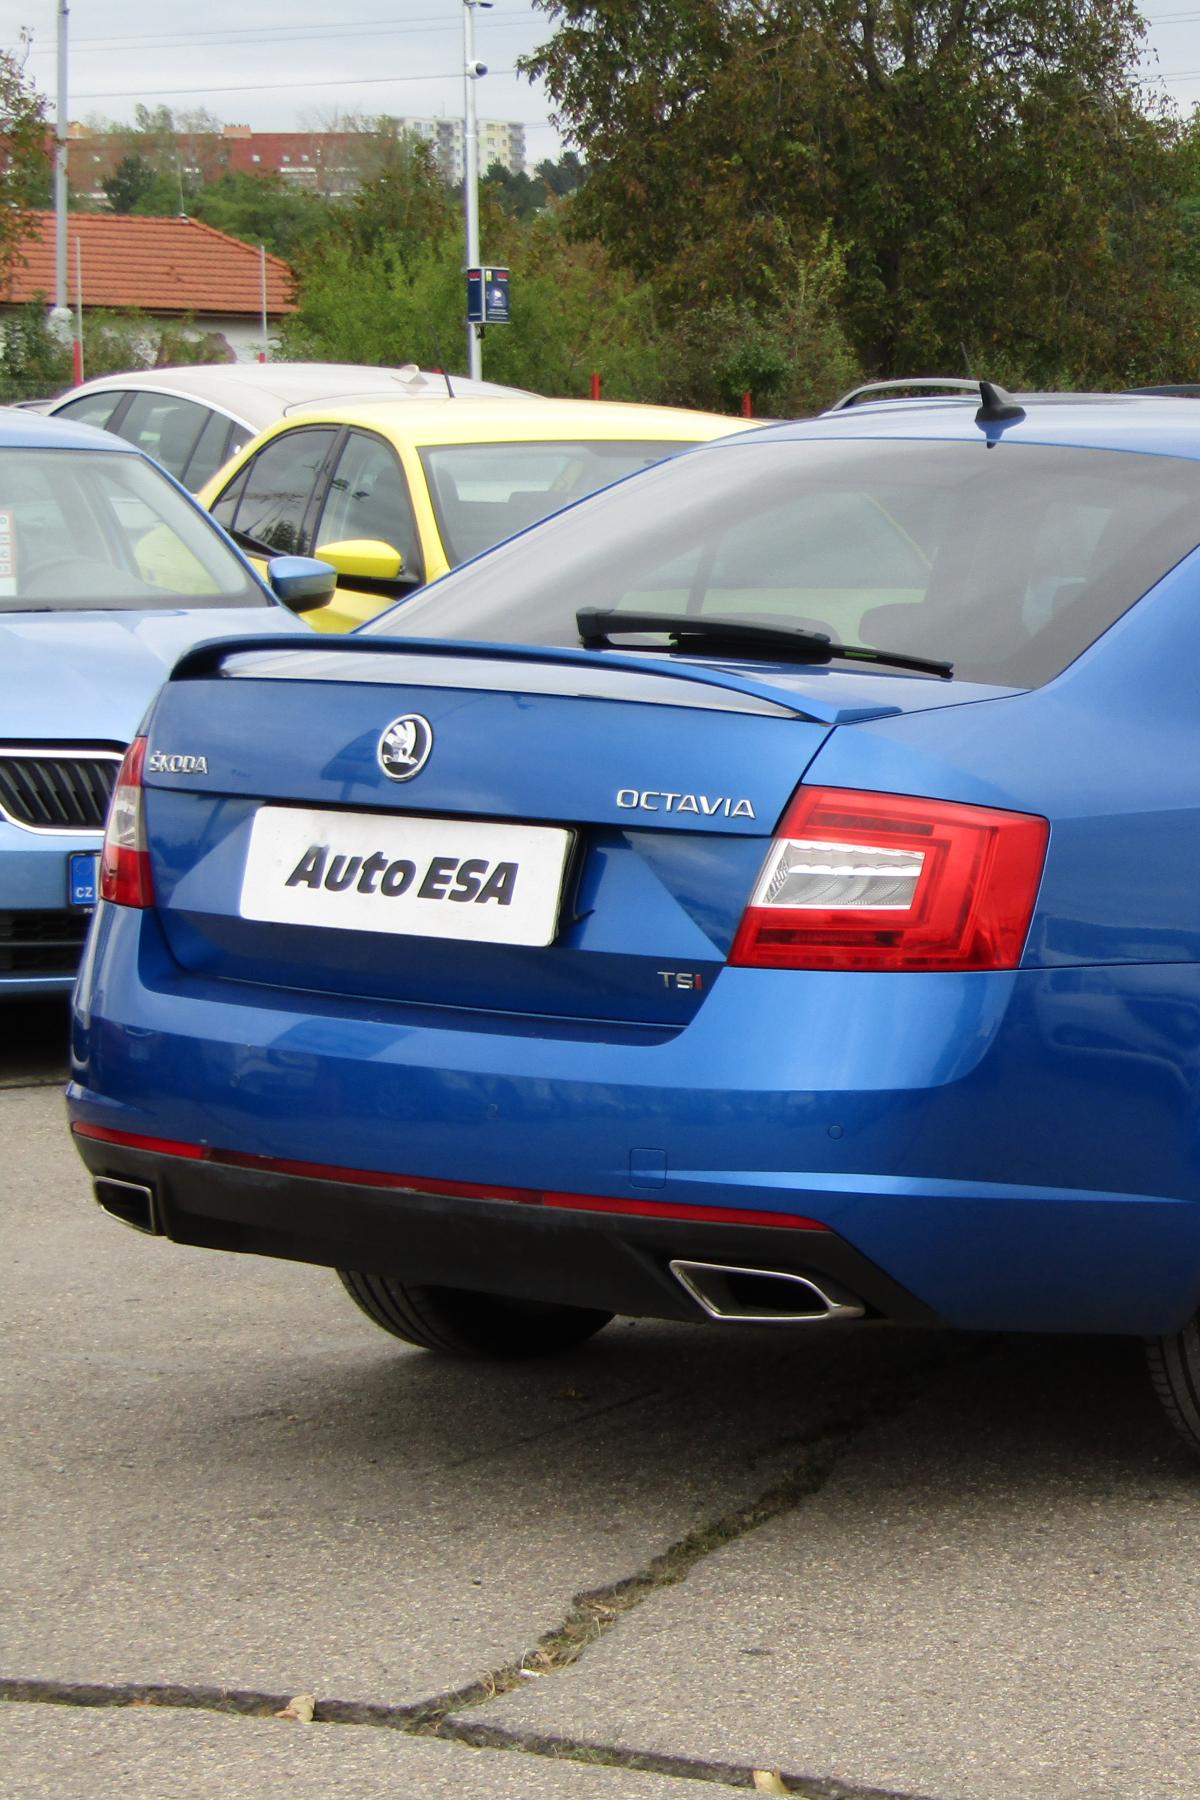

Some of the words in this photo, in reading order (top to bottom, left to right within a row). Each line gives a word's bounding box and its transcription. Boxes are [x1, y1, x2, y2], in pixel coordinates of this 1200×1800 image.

[149, 750, 208, 774] ŠKODA
[616, 789, 757, 820] OCTAVIA
[284, 845, 416, 898] Auto
[416, 856, 519, 906] ESA
[75, 886, 94, 898] CZ
[656, 971, 702, 991] TSI
